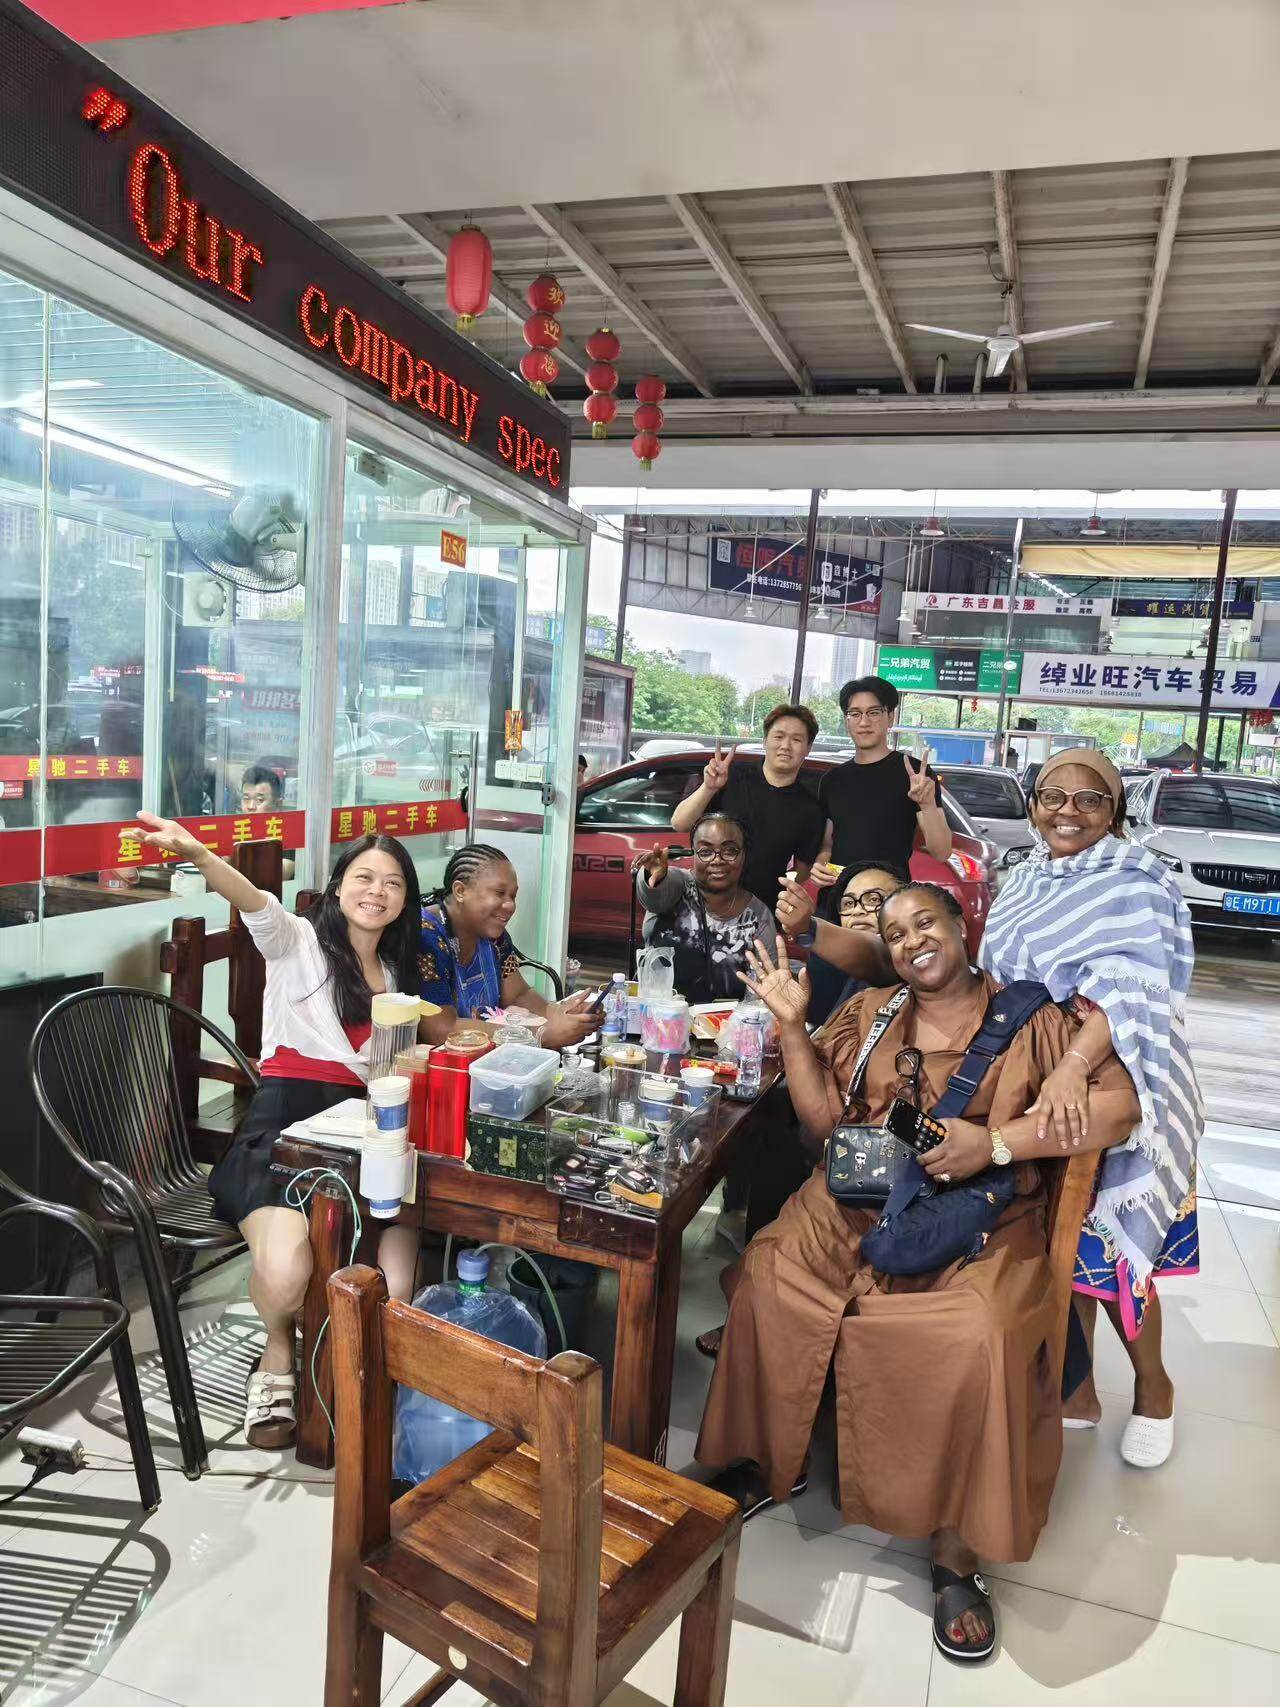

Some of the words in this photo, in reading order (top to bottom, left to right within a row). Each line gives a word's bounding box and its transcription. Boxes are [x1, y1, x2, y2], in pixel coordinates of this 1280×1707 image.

[298, 282, 480, 443] company
[496, 414, 560, 488] spec
[443, 535, 465, 563] E56
[947, 596, 1037, 611] 广东吉昌金服
[880, 657, 931, 669] 二兄弟汽贸
[1040, 662, 1258, 697] 绰业旺汽车贸易
[338, 804, 438, 838] 星驰二手车
[117, 816, 284, 862] 星二手车
